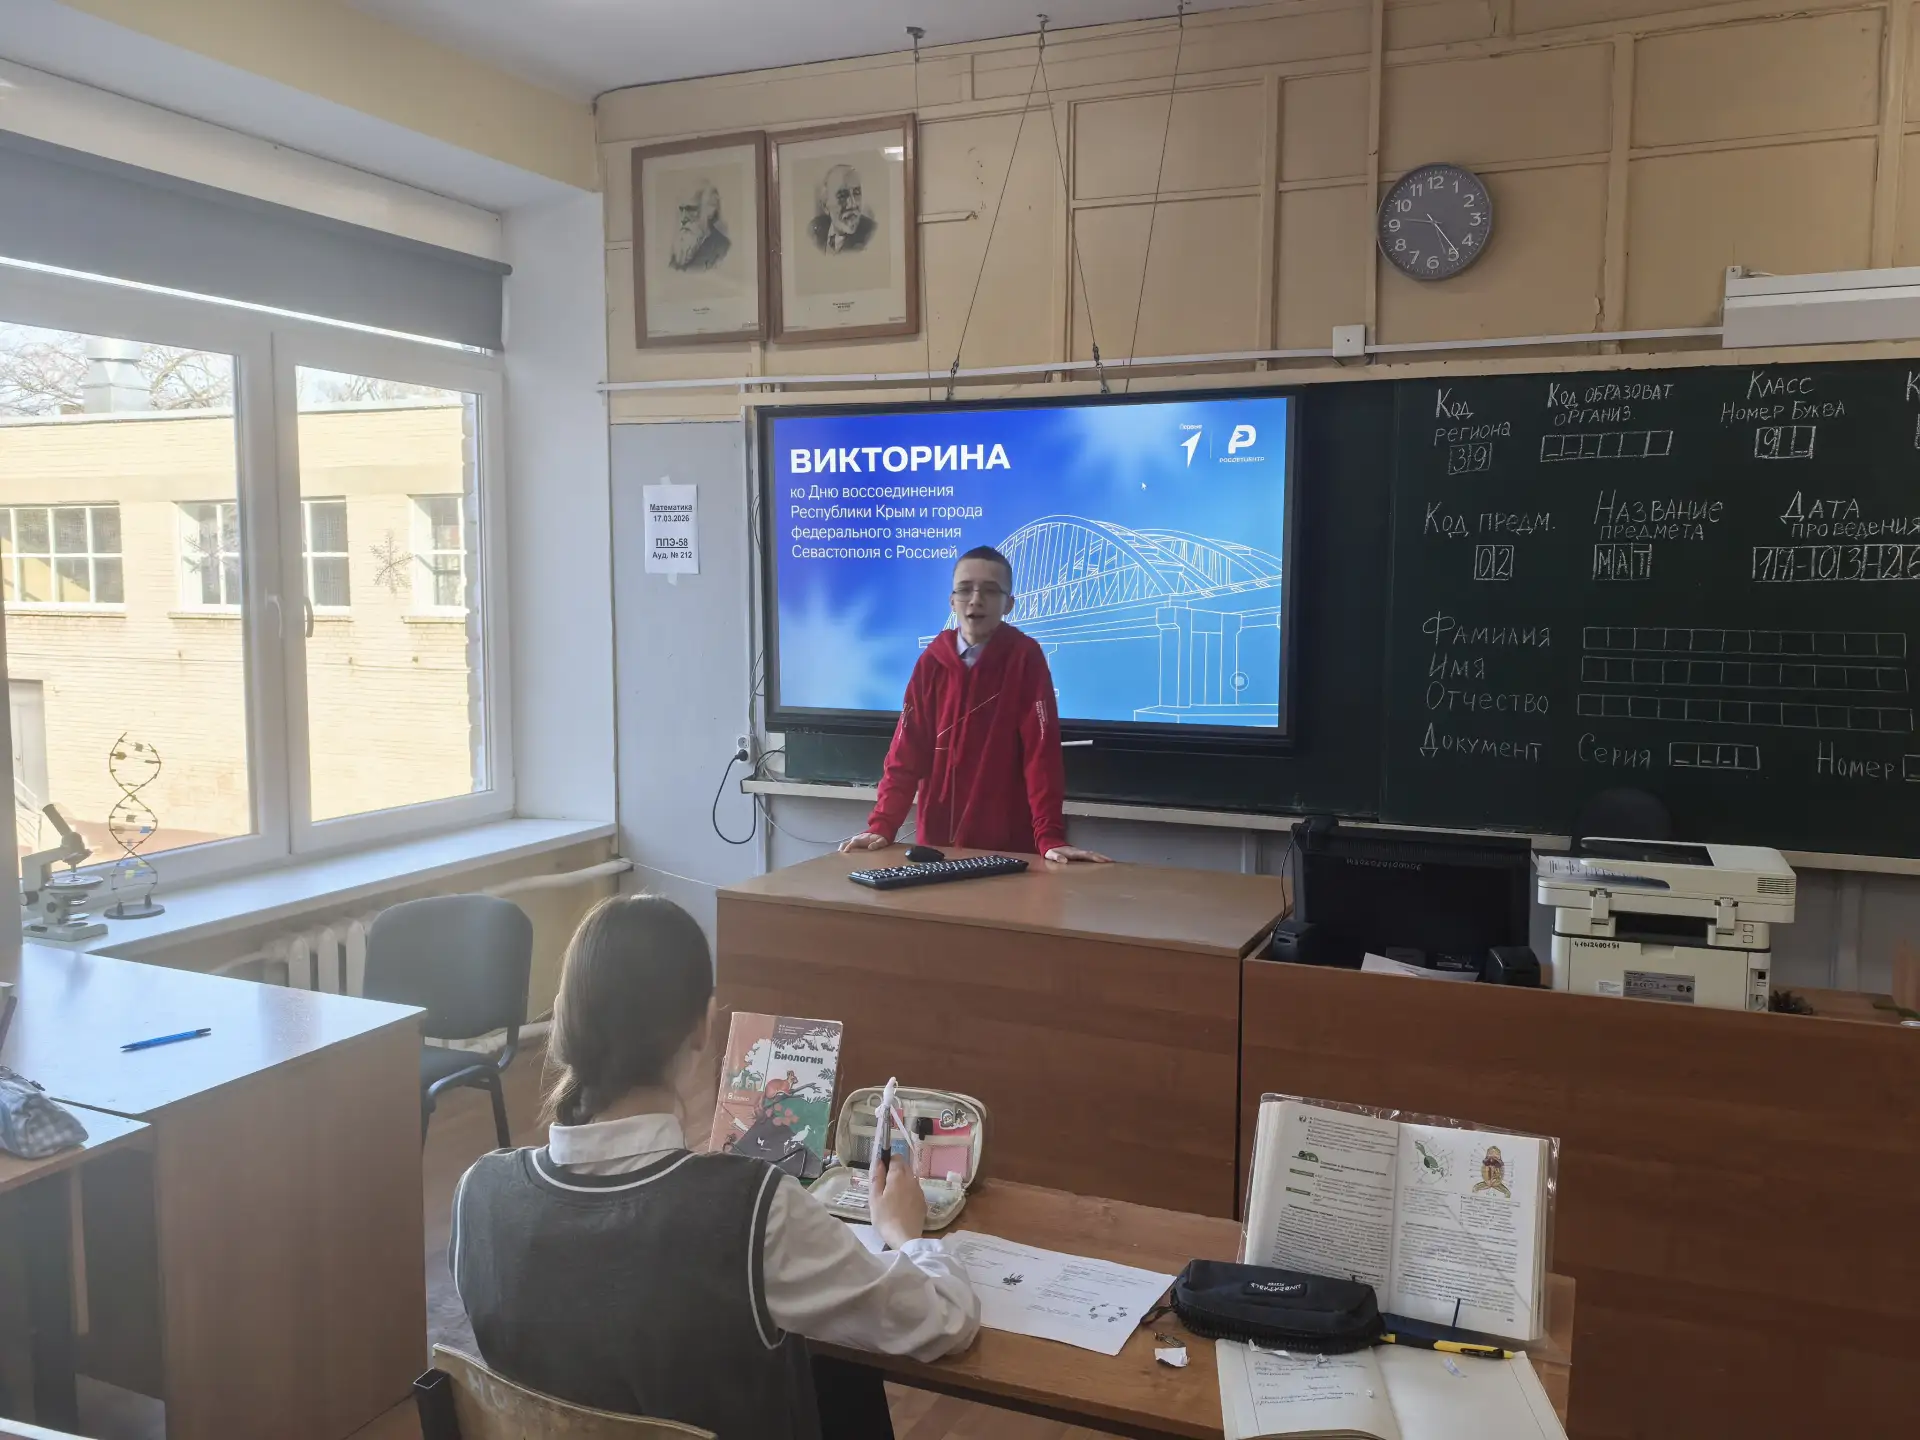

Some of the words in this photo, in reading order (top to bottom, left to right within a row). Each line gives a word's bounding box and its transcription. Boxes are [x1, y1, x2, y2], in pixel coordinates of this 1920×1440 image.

[1427, 176, 1444, 189] 12
[1452, 180, 1459, 193] 1
[1410, 183, 1423, 197] 11
[1394, 199, 1412, 213] 10
[1463, 194, 1475, 208] 2
[1388, 219, 1400, 232] 9
[1469, 212, 1481, 226] 3
[1394, 238, 1407, 251] 8
[1461, 233, 1474, 246] 4
[1409, 250, 1420, 264] 7
[1447, 247, 1460, 262] 5
[1426, 255, 1440, 269] 6
[1547, 382, 1579, 409] Код
[1435, 388, 1474, 420] Код
[790, 443, 1011, 474] ВИКТОРИНА
[790, 488, 805, 499] ко
[808, 485, 838, 500] Дню
[842, 486, 954, 500] воссоединения
[649, 503, 693, 511] Математика
[791, 504, 872, 522] Республики
[876, 504, 915, 520] Крым
[919, 506, 928, 517] и
[931, 505, 983, 520] города
[653, 514, 690, 522] 17.03.2026
[1424, 501, 1469, 538] Код
[791, 525, 891, 542] федерального
[895, 526, 962, 539] значения
[655, 538, 689, 547] ППЭ-58
[652, 551, 669, 560] Ауд.
[670, 551, 679, 559] №
[680, 551, 693, 559] 212
[791, 545, 881, 559] Севастополя
[884, 548, 893, 559] с
[896, 544, 958, 559] Россией
[1578, 732, 1650, 769] Серия
[1817, 740, 1895, 780] Номер
[773, 1051, 824, 1065] Биология
[727, 1092, 734, 1100] 8
